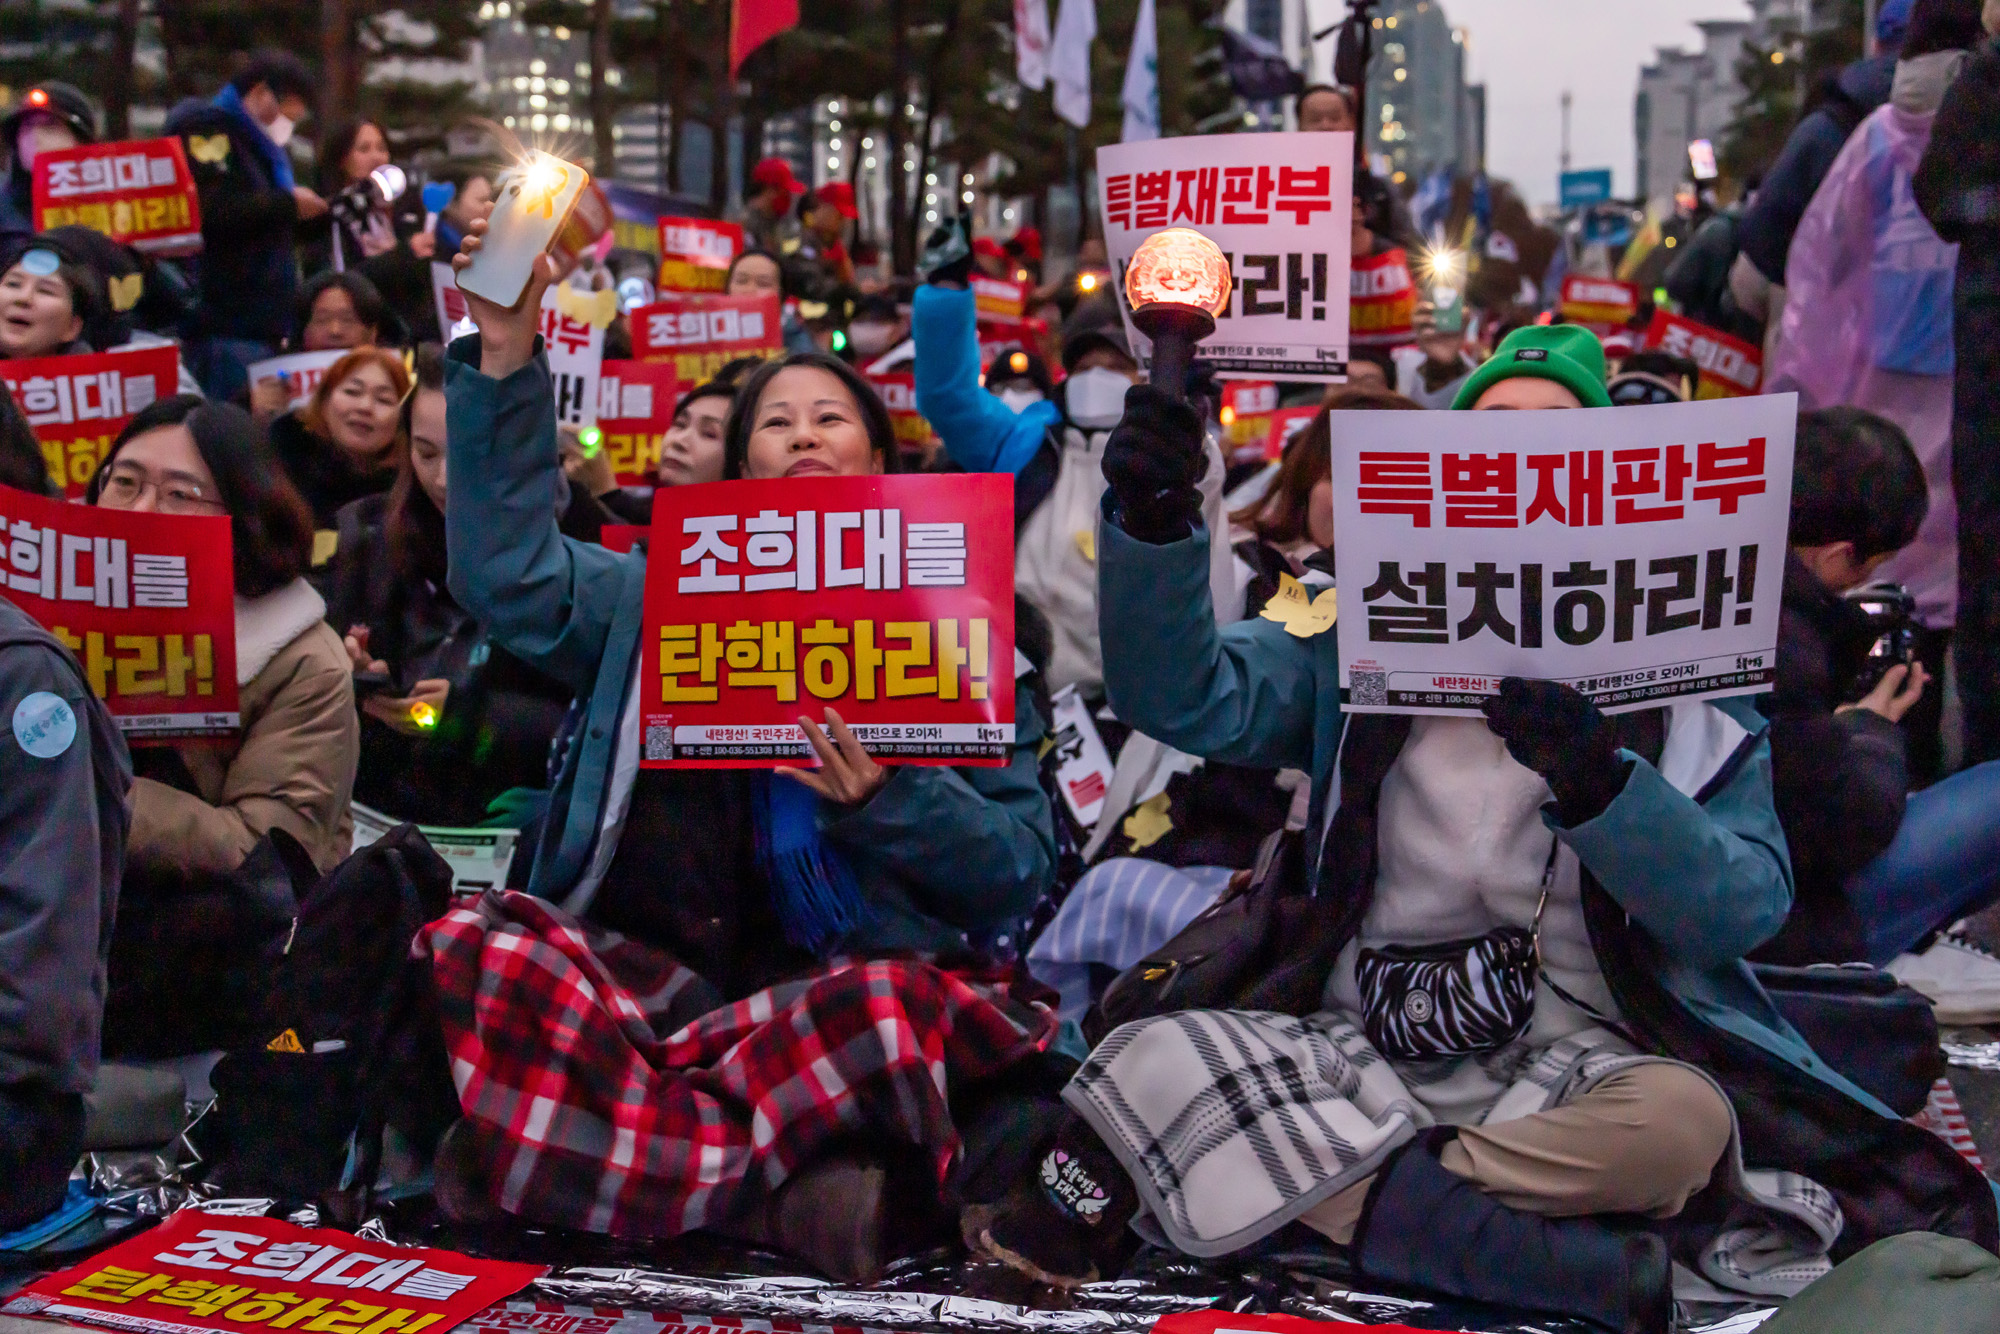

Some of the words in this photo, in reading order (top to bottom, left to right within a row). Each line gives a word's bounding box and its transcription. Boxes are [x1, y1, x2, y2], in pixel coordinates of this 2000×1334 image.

[1106, 165, 1332, 231] 특별재판부
[1357, 437, 1767, 528] 특별재판부
[0, 515, 189, 609] 희대를
[678, 508, 967, 594] 조희대를
[1362, 543, 1759, 648] 설치하라!
[659, 618, 990, 702] 탄핵하라!
[1433, 677, 1488, 691] 내란청산!
[1575, 669, 1657, 693] 촛불대행진으로
[1661, 664, 1700, 680] 모이자!
[905, 726, 942, 740] 모이자!
[1425, 694, 1442, 703] 신한
[705, 728, 749, 741] 내란청산!
[153, 1229, 477, 1301] 조희대를
